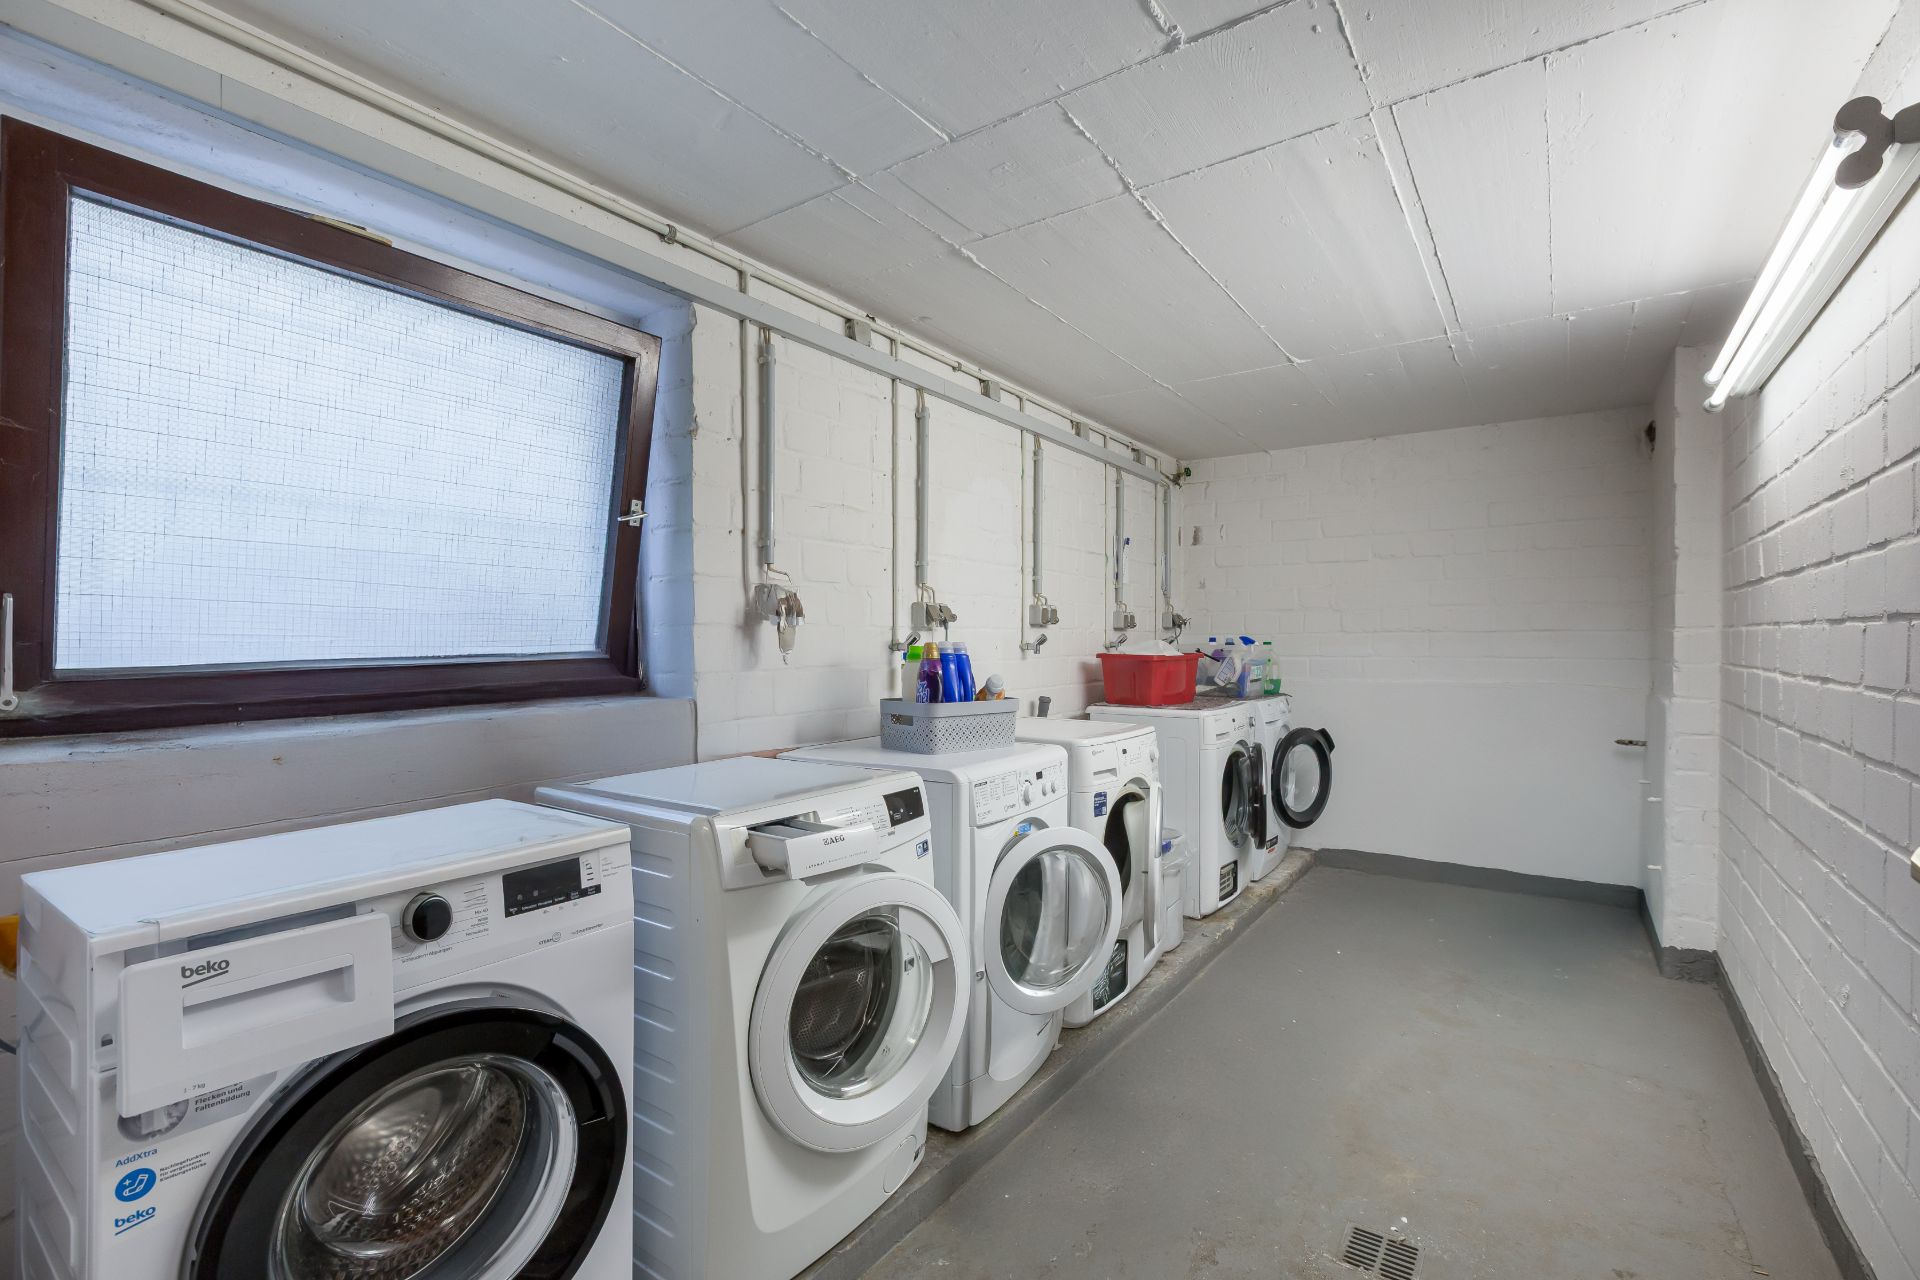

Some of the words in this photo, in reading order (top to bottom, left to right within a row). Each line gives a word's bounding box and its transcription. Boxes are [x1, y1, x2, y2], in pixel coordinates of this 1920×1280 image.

[829, 834, 845, 845] AEG
[181, 960, 230, 979] beko
[195, 1091, 227, 1105] Flecken
[227, 1084, 243, 1095] und
[195, 1090, 251, 1112] Faltenbildung
[115, 1148, 158, 1168] AddXtra
[114, 1206, 156, 1228] beko
